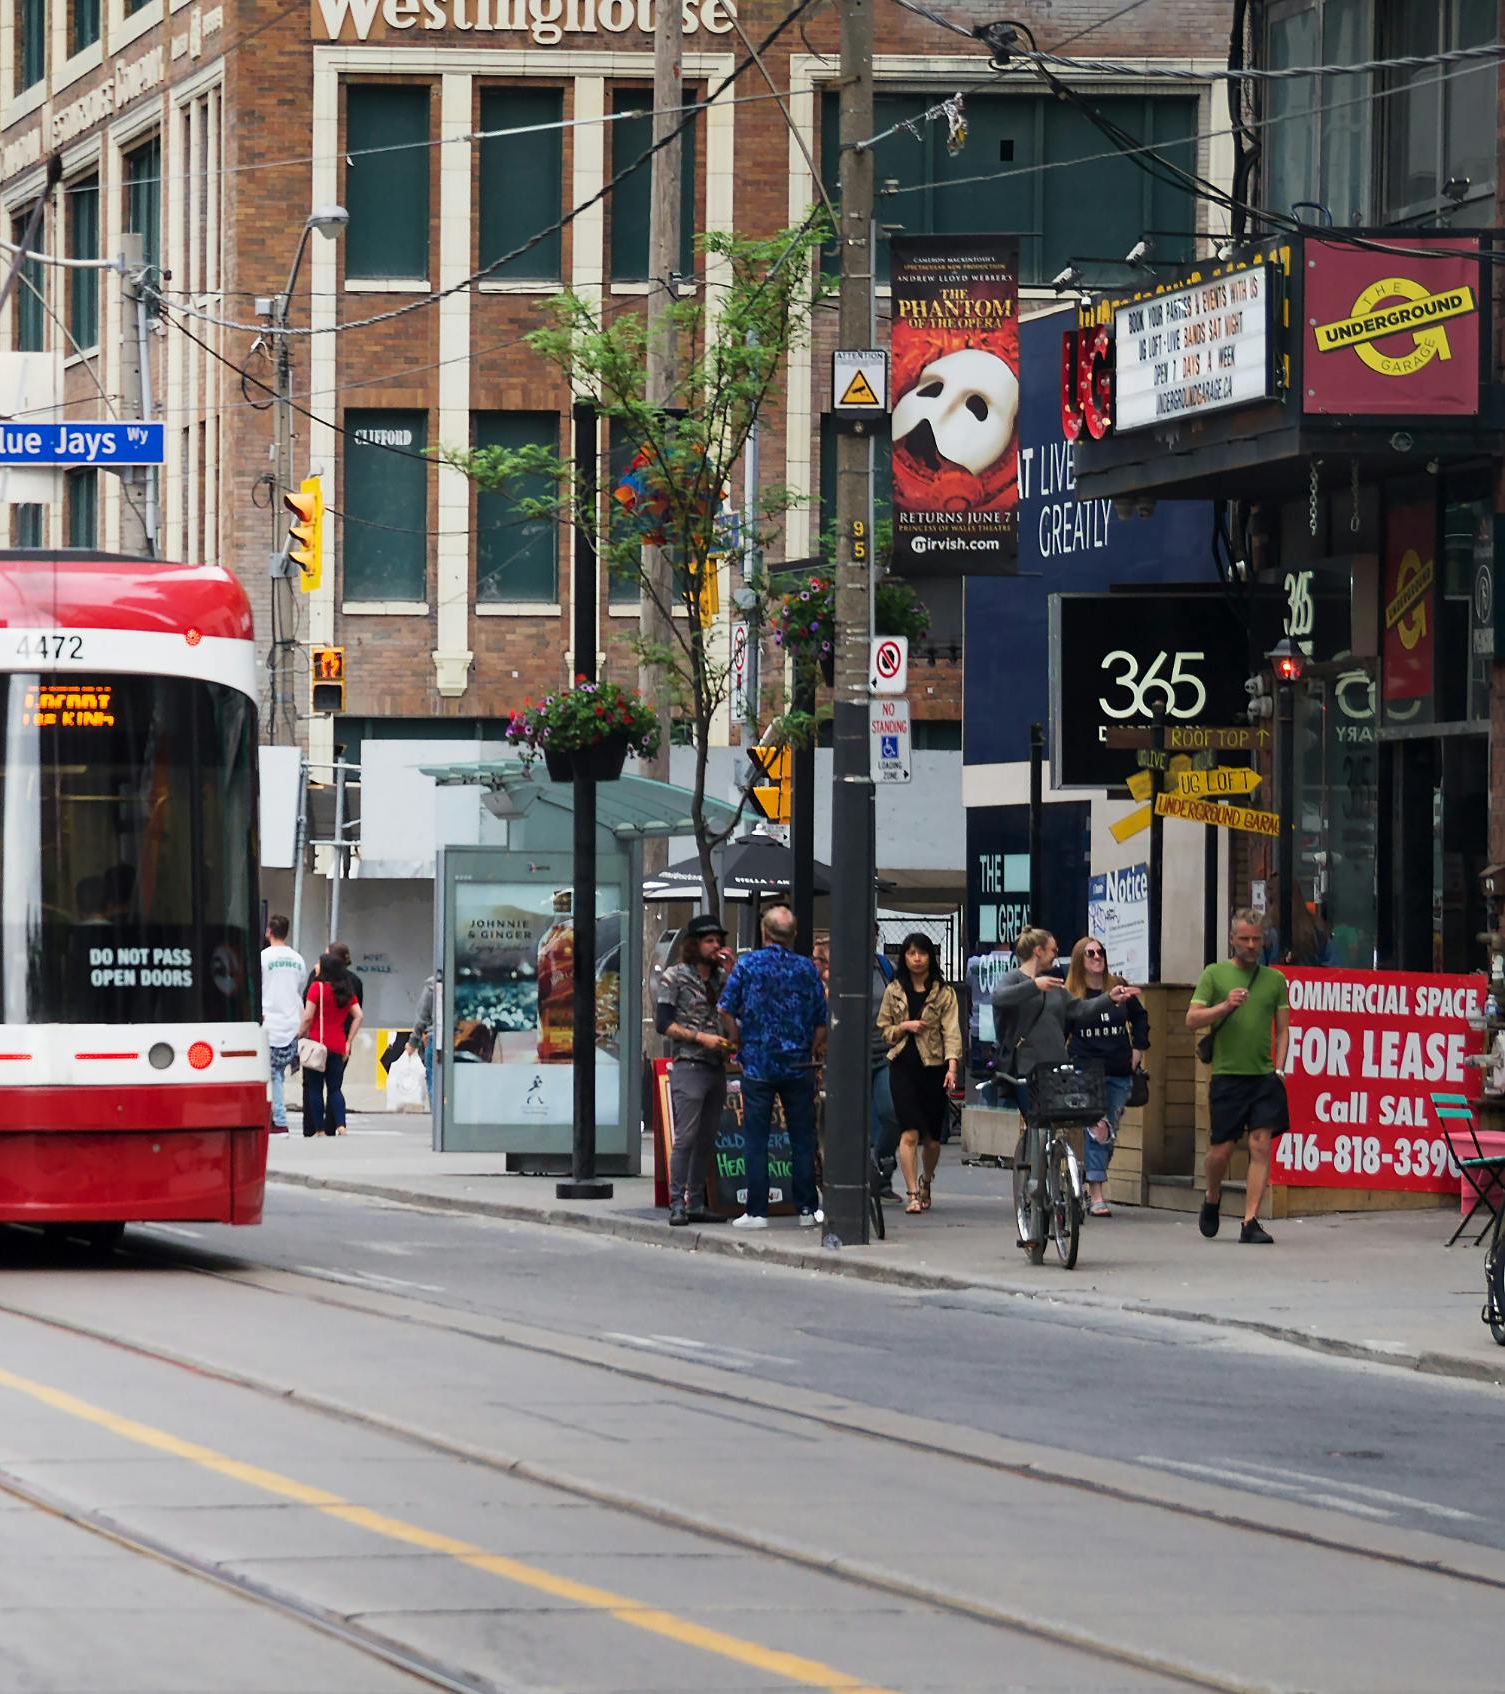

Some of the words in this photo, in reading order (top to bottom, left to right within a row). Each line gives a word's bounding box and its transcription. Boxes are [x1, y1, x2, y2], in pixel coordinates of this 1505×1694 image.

[940, 288, 968, 300] THE
[1128, 309, 1145, 334] BOOK
[1202, 284, 1227, 313] EVENTS
[1230, 279, 1247, 305] WITH
[1250, 275, 1258, 299] US
[1363, 281, 1402, 307] THE
[898, 299, 1013, 318] PHANTOM
[1326, 295, 1463, 343] UNDERGROUND
[908, 318, 926, 329] OF
[930, 318, 955, 329] THE
[957, 317, 1002, 329] OPERA
[1184, 323, 1206, 348] BANDS
[1209, 317, 1222, 342] SAT
[1183, 353, 1200, 378] DAYS
[1218, 343, 1236, 369] WEEK
[1381, 337, 1436, 373] GARAGE
[54, 427, 117, 461] Jays
[127, 427, 148, 445] Wy
[1041, 440, 1077, 495] LIVE
[853, 520, 864, 536] 9
[899, 511, 963, 524] RETURNS
[967, 511, 1000, 524] JUNE
[1004, 511, 1011, 522] 7
[1039, 499, 1111, 557] GREATLY
[854, 542, 865, 557] 5
[911, 536, 999, 553] mirvish.com
[16, 636, 84, 660] 4472
[1099, 650, 1206, 719] 365
[882, 703, 895, 716] NO
[872, 720, 907, 734] STANDING
[1171, 729, 1213, 747] ROOF
[1217, 729, 1249, 747] TOP
[1180, 774, 1200, 795] UG
[1206, 770, 1250, 792] LOFT
[1157, 796, 1241, 826] UNDERGROUND
[979, 854, 1002, 893] THE
[1106, 864, 1148, 903] Notice
[468, 931, 475, 939] &
[480, 930, 533, 940] GINGER
[471, 919, 530, 929] JOHNNIE
[998, 904, 1031, 943] GREA
[89, 948, 114, 966] DO
[117, 948, 150, 966] NOT
[153, 948, 193, 966] PASS
[90, 969, 136, 987] OPEN
[140, 969, 193, 987] DOORS
[1286, 979, 1410, 1016] OMMERCIAL
[1415, 986, 1478, 1018] SPACE
[1284, 1025, 1351, 1077] FOR
[1361, 1029, 1466, 1082] LEASE
[1315, 1092, 1368, 1123] Call
[1379, 1095, 1428, 1127] SAL
